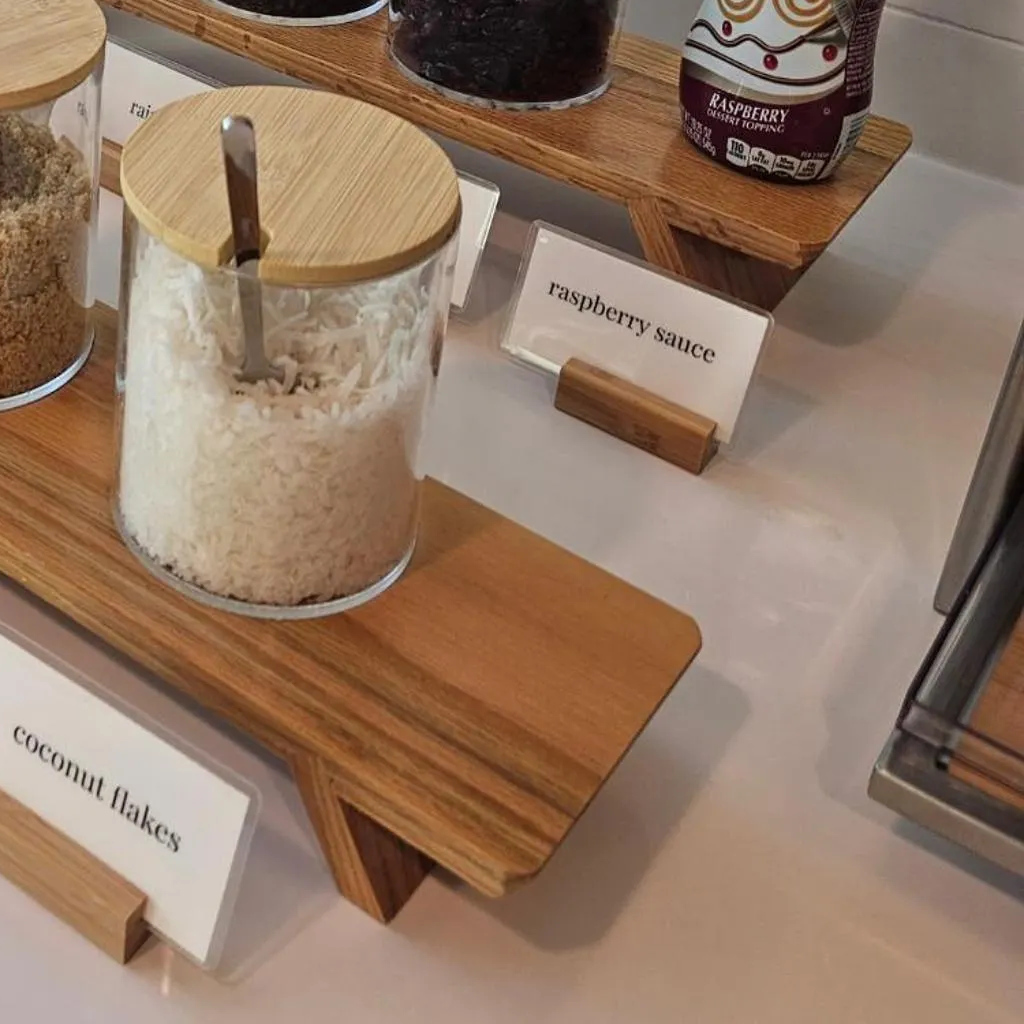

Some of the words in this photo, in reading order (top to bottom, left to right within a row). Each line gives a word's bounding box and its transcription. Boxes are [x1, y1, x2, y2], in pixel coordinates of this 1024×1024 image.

[130, 102, 152, 119] rai
[706, 107, 740, 127] DESSERT
[742, 120, 785, 133] TOPPING
[708, 92, 790, 124] RASPBERRY
[731, 140, 744, 154] 110
[547, 280, 652, 337] raspberry
[653, 324, 716, 364] sauce
[13, 724, 104, 801] coconut
[110, 785, 182, 853] flakes
